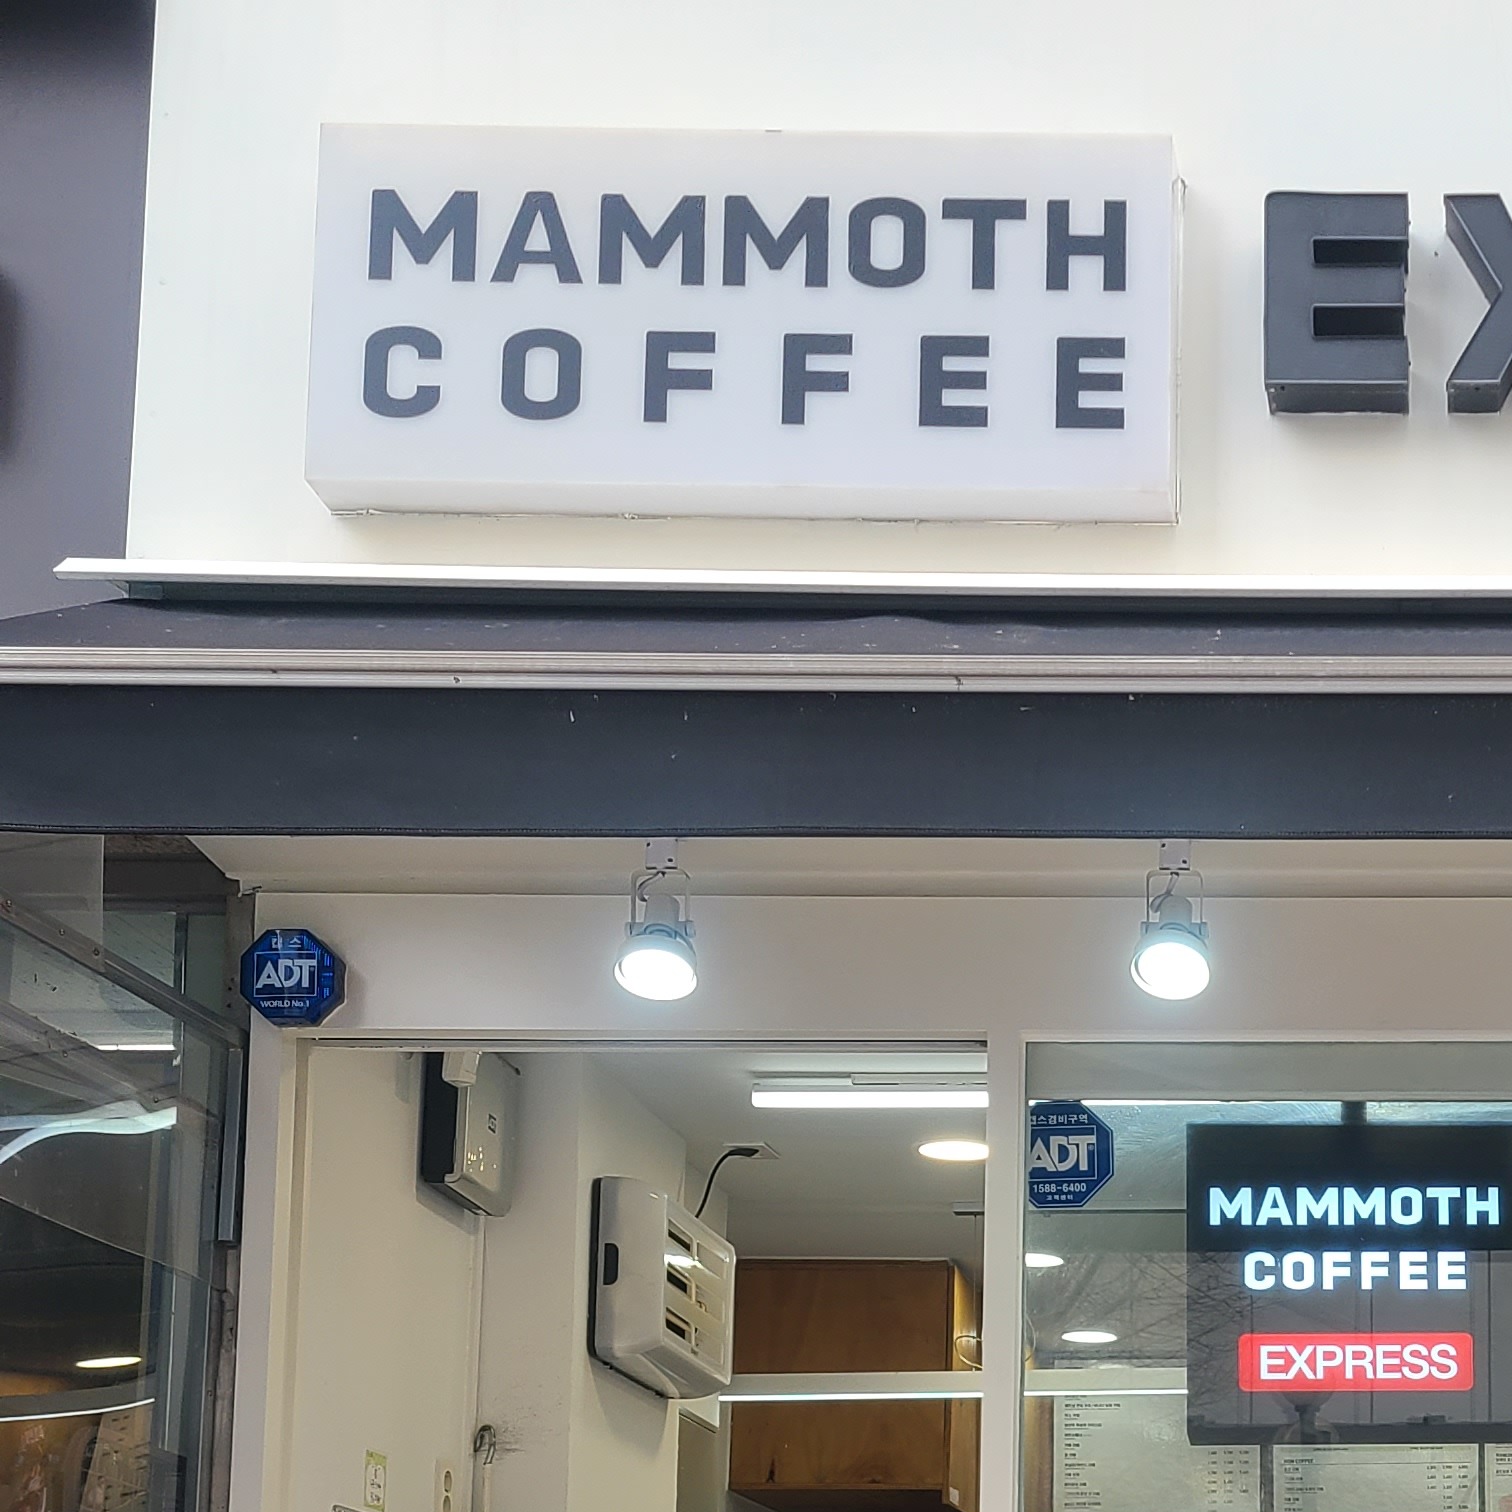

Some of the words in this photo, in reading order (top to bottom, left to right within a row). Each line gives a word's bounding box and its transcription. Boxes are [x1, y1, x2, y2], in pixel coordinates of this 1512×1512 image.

[367, 188, 1128, 292] MAMMOTH
[361, 325, 1127, 429] COFFEE
[255, 959, 317, 988] ADT
[1028, 1135, 1096, 1171] ADT
[1033, 1182, 1087, 1193] 1588-6400
[1208, 1186, 1501, 1227] MAMMOTH
[1243, 1251, 1468, 1291] COFFEE
[1258, 1342, 1459, 1381] EXPRESS
